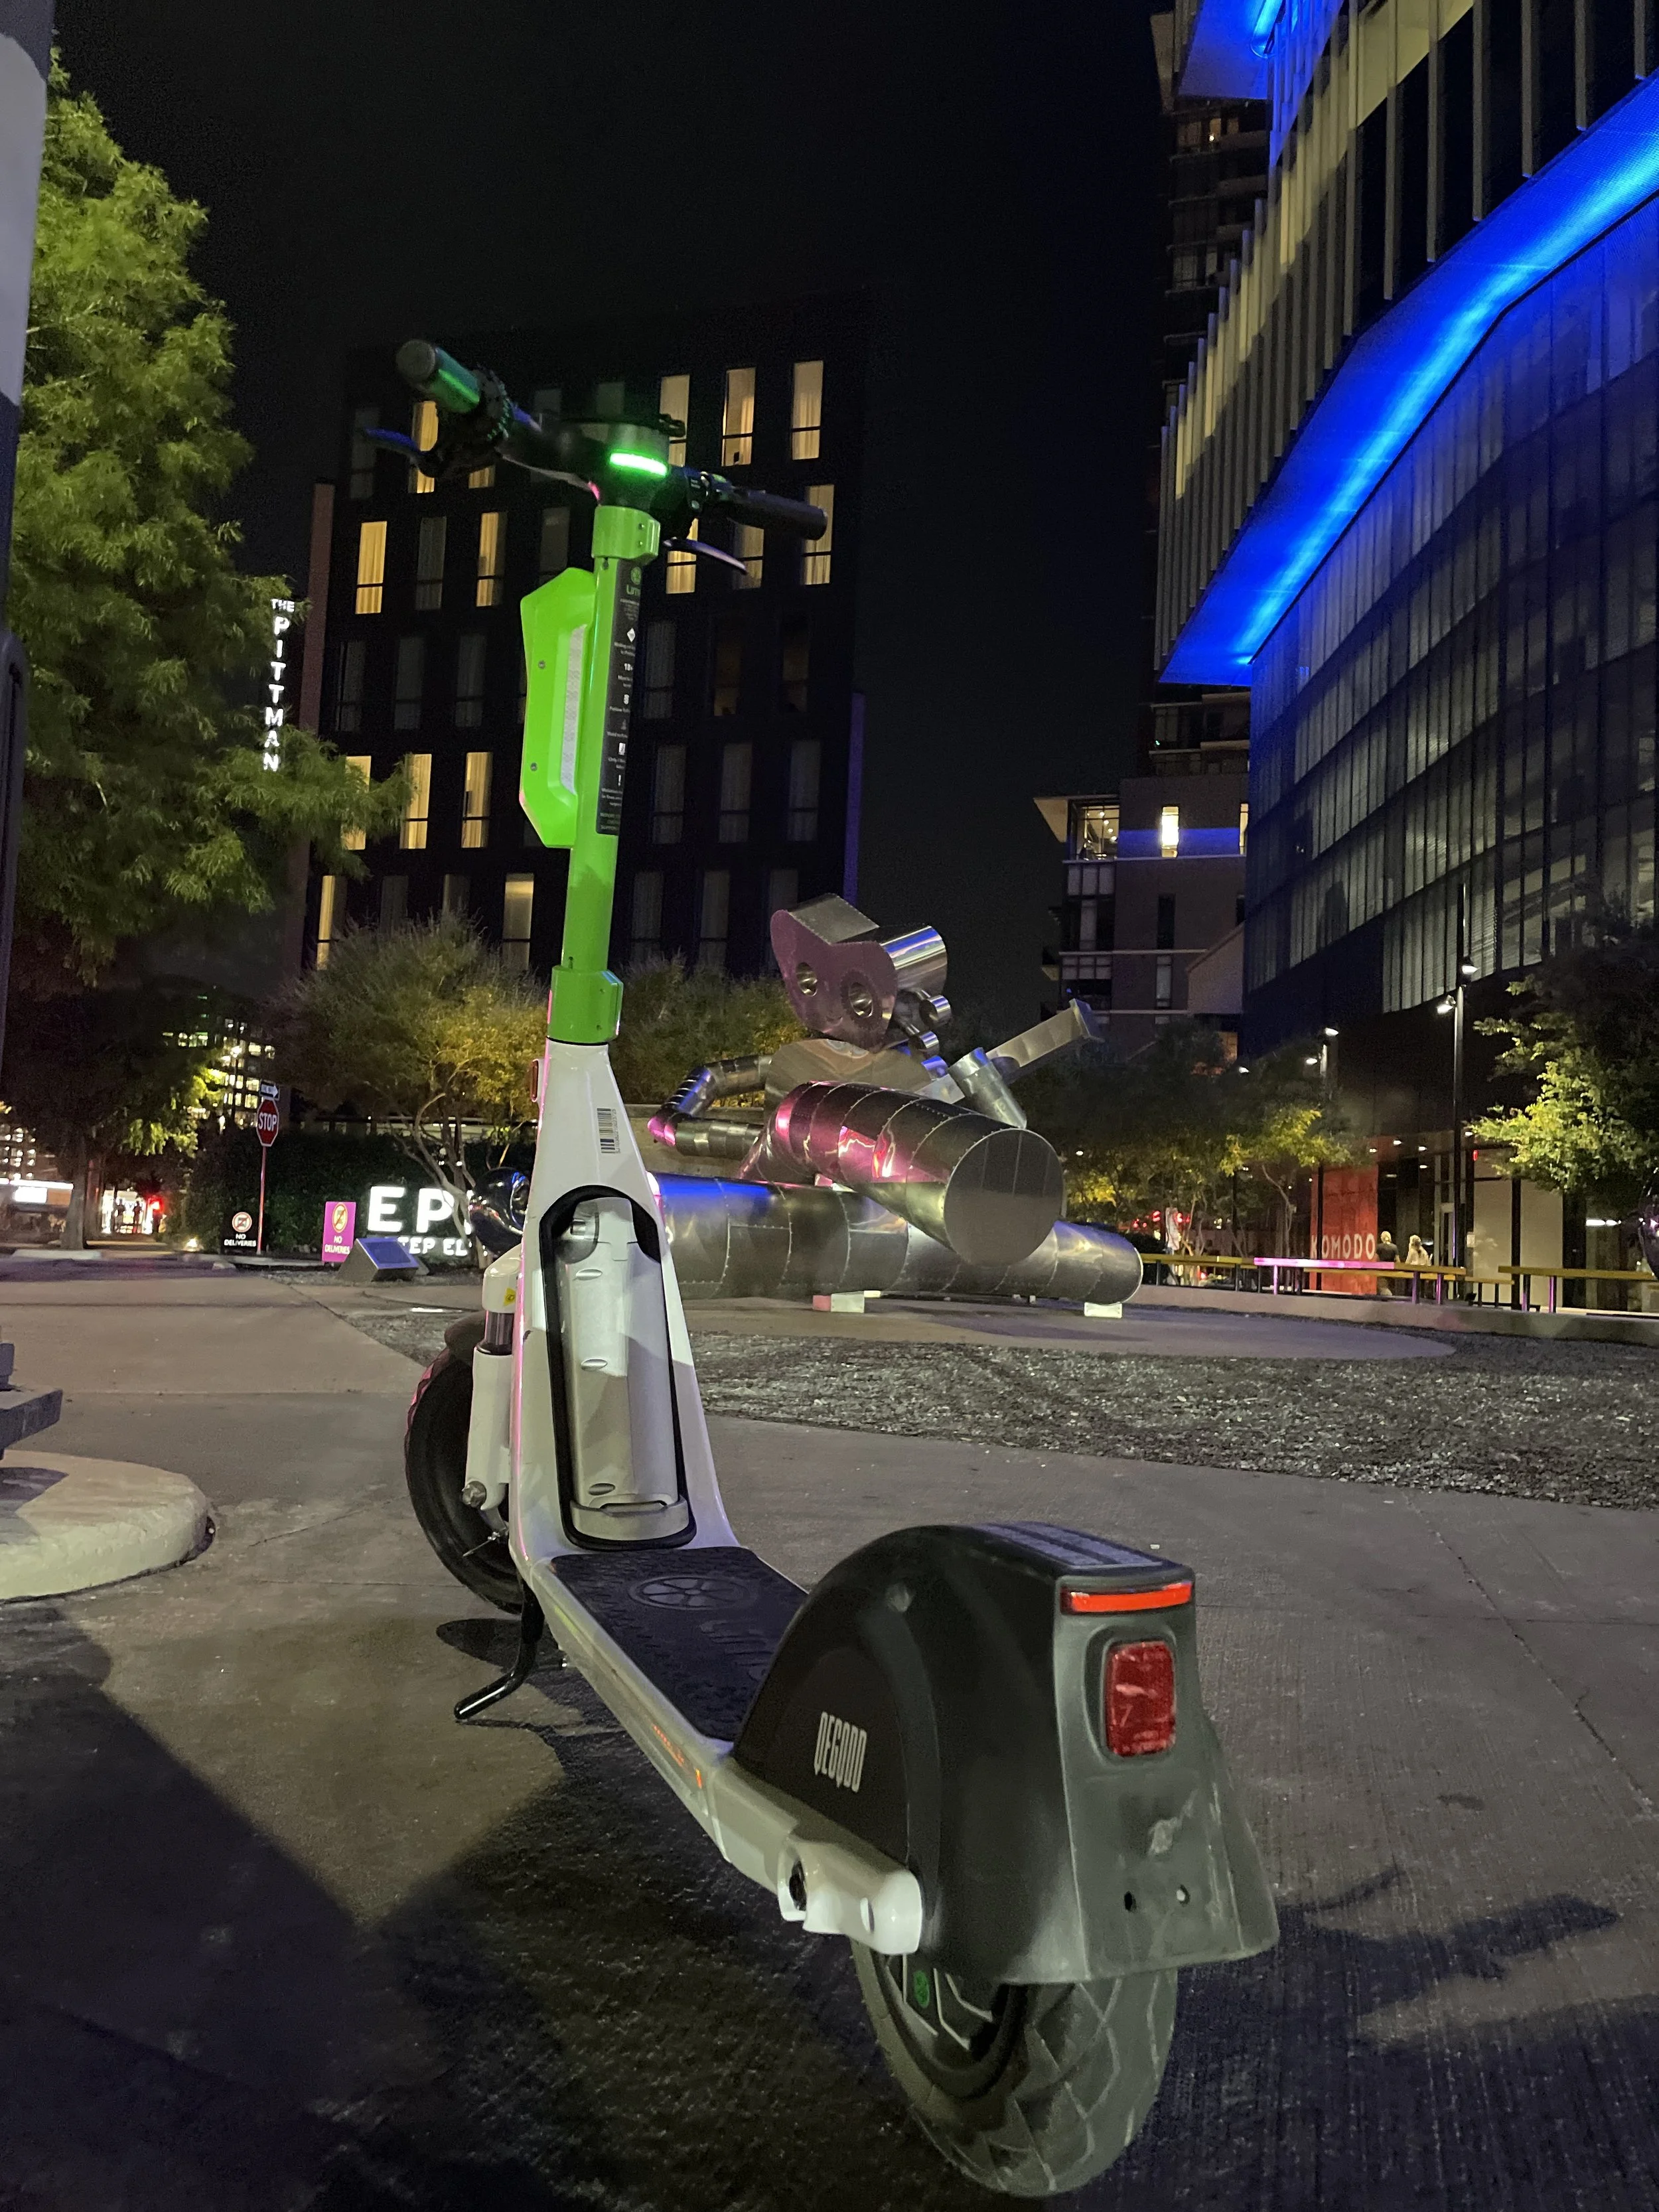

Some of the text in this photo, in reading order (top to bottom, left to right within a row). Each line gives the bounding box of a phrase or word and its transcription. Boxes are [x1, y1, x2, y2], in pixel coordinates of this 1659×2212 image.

[271, 598, 295, 613] THE
[263, 615, 291, 772] PITTMAN
[258, 1112, 277, 1132] STOP
[333, 1235, 342, 1244] NO
[1311, 1233, 1376, 1260] KOMODO
[325, 1244, 350, 1255] DELIVERIES
